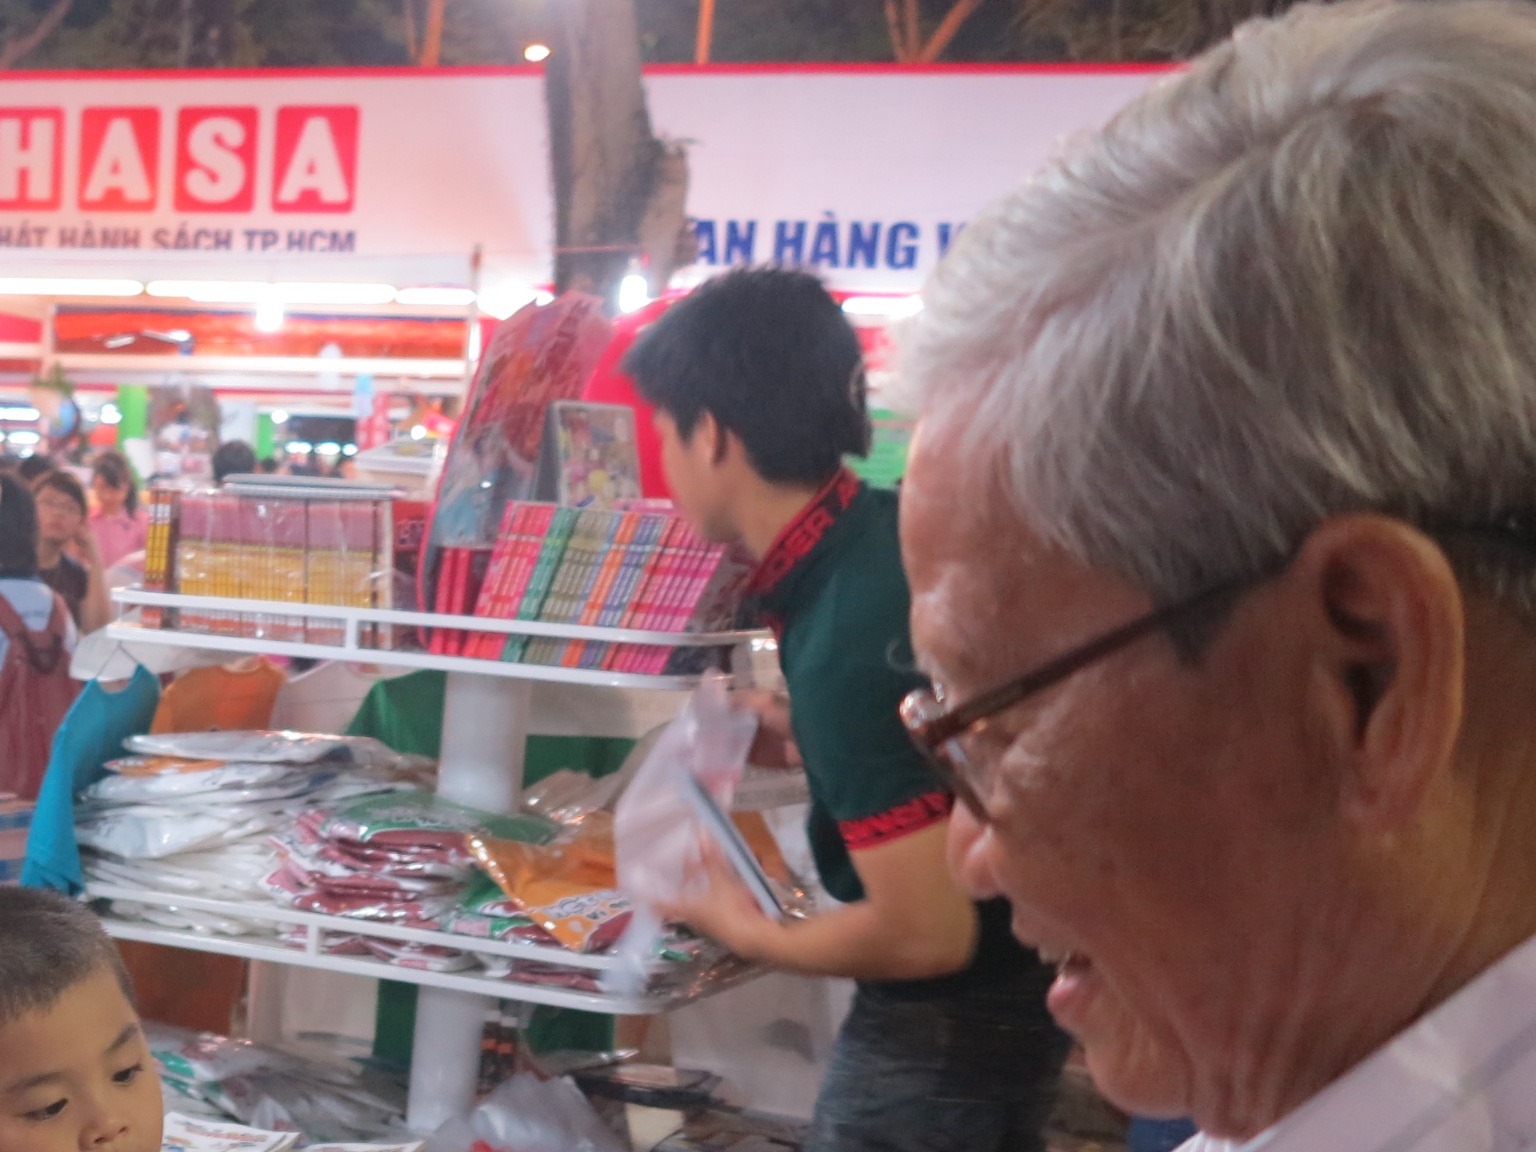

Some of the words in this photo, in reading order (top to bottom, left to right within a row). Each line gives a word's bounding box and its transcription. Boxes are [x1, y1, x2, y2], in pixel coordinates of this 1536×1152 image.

[58, 221, 142, 249] HÀNH
[152, 221, 234, 250] SÁCH
[773, 210, 921, 270] HÀNG
